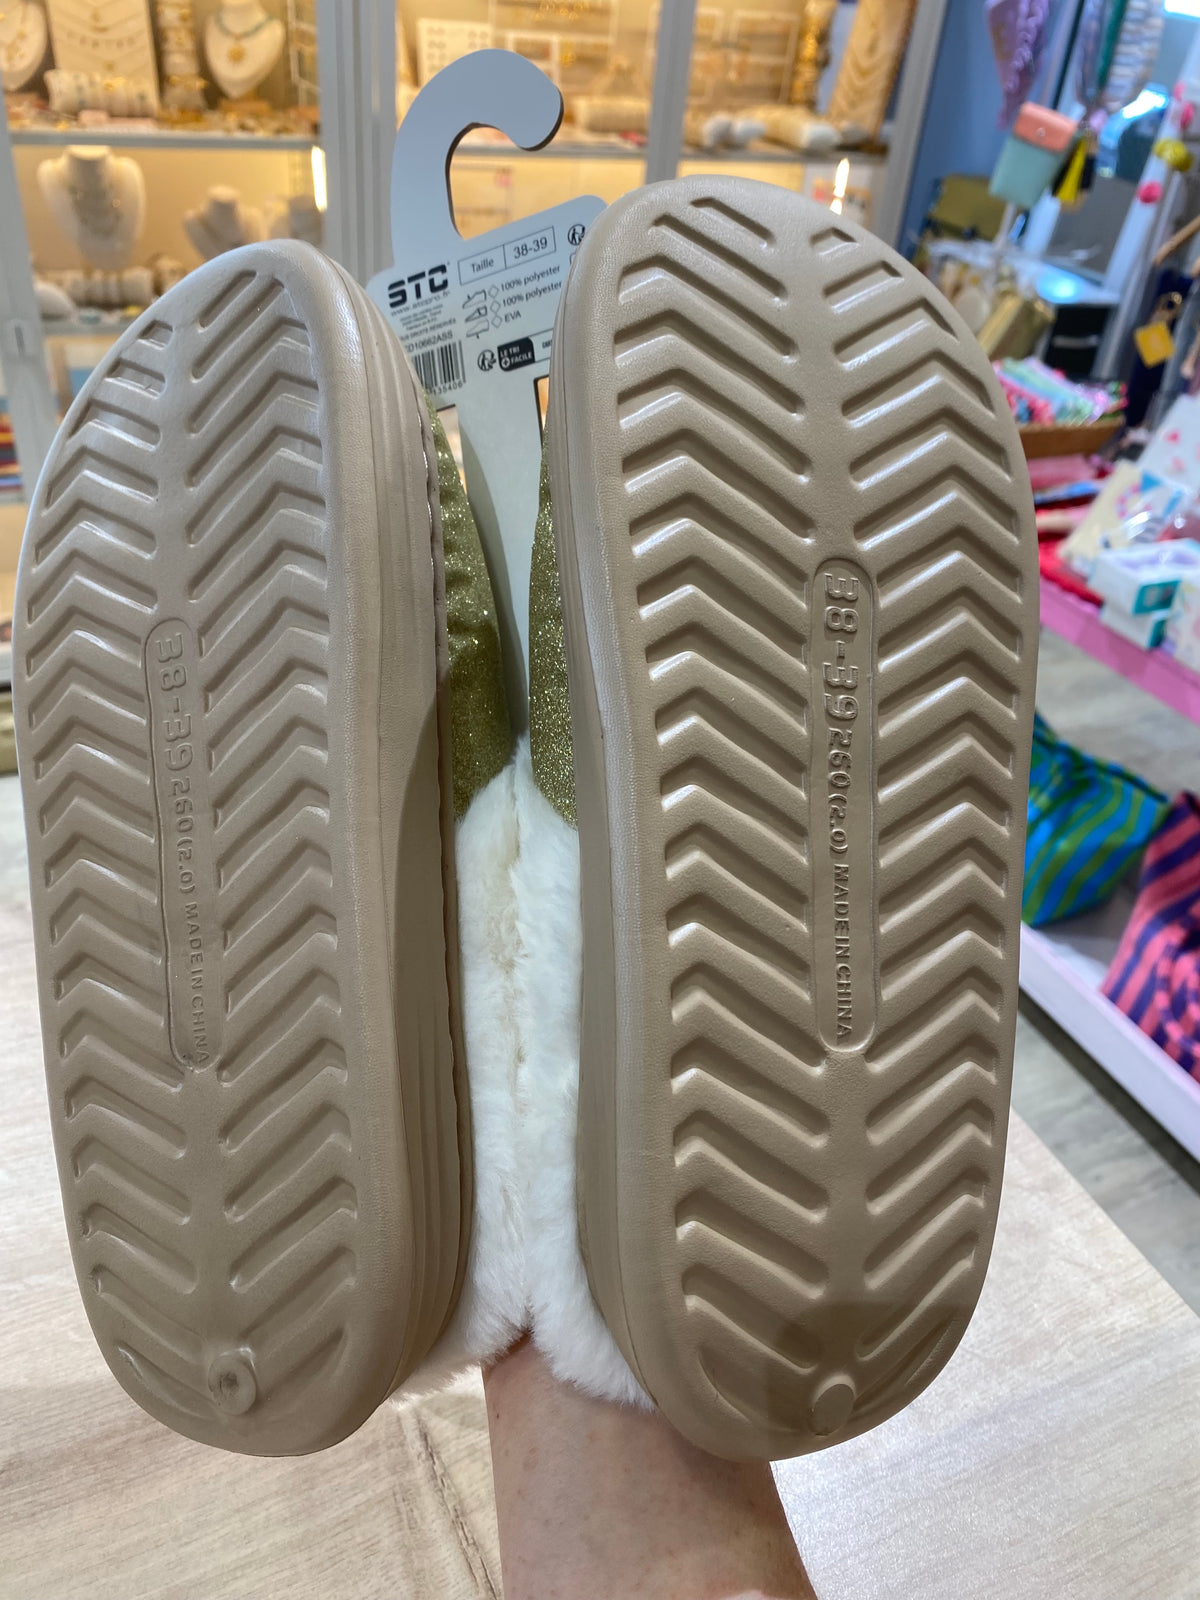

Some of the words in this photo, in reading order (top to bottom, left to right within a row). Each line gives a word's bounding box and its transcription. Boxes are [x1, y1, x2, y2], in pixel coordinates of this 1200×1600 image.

[513, 236, 548, 260] 38-39
[471, 258, 494, 274] Taille
[501, 280, 522, 292] 100%
[523, 265, 561, 286] polyester
[387, 264, 449, 309] STC
[503, 295, 524, 307] 100%
[525, 281, 562, 302] polyester
[504, 310, 522, 323] EVA
[821, 572, 859, 720] 38-39
[156, 632, 194, 772] 38-39
[835, 964, 852, 1039] CHINA
